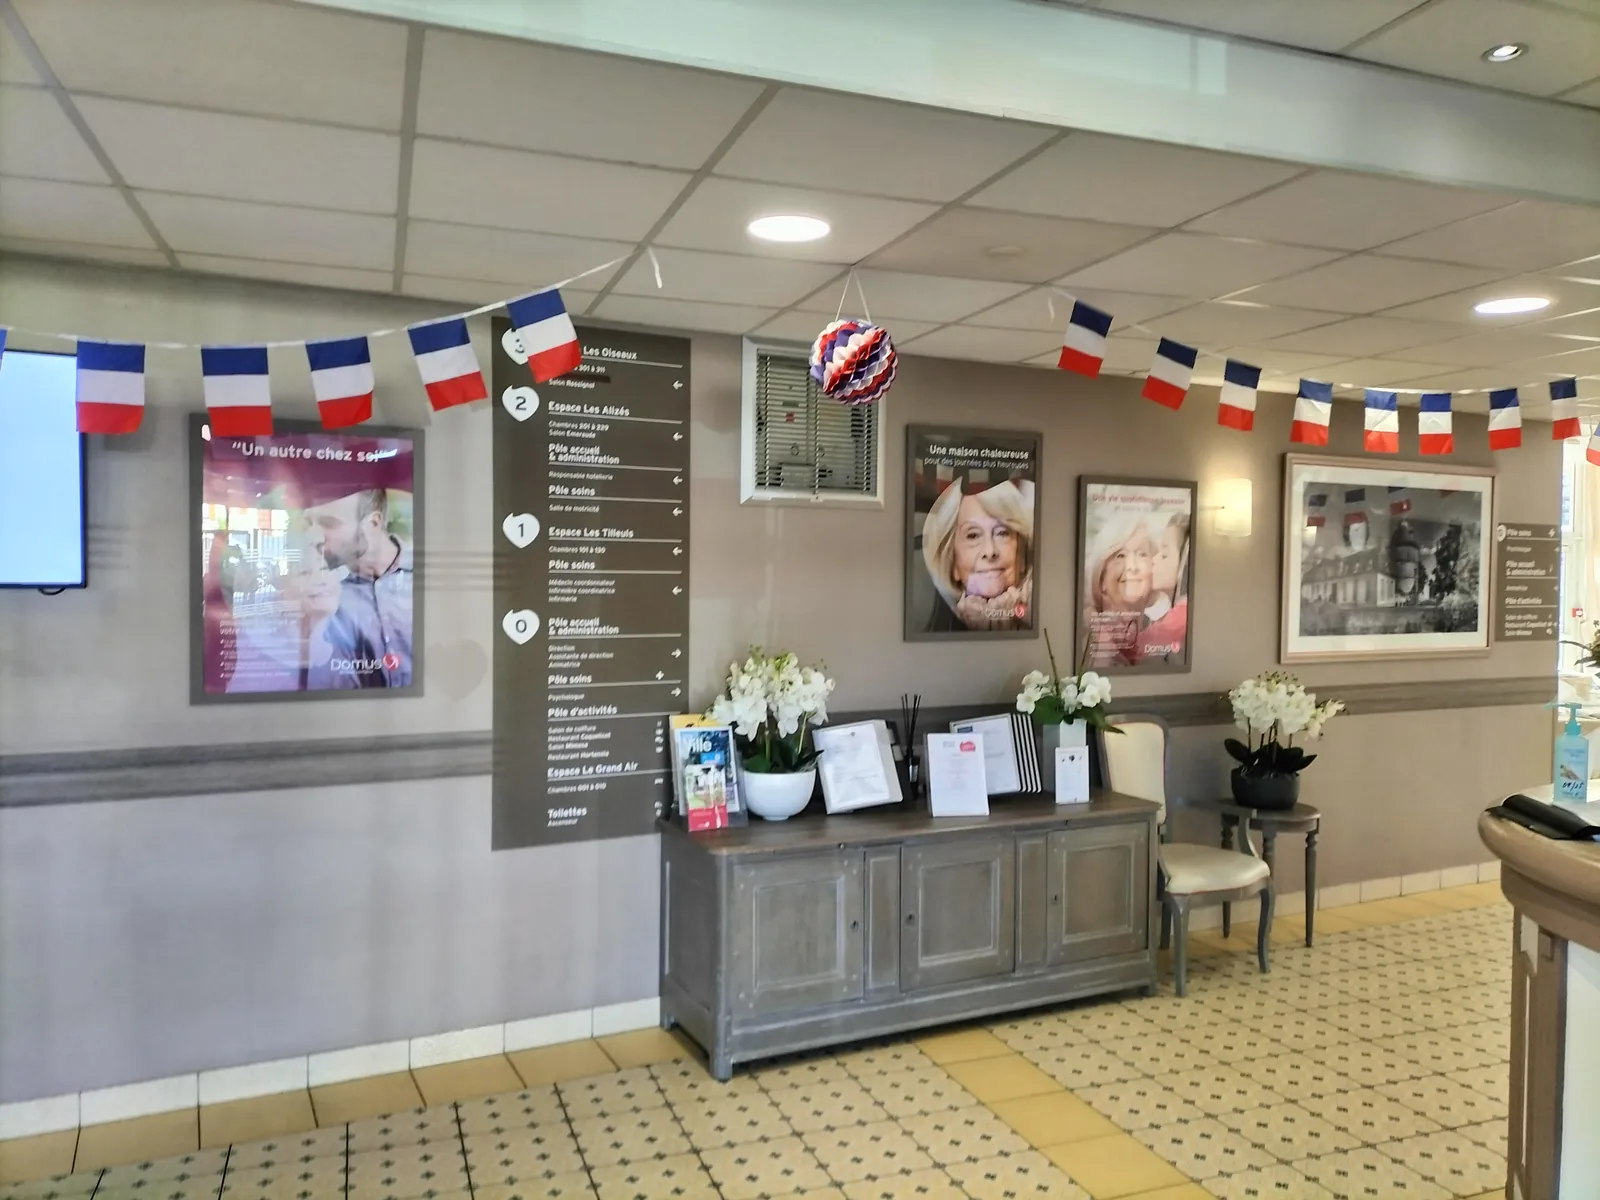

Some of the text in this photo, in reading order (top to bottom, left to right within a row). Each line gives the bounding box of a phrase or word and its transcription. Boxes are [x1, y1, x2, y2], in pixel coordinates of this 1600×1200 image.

[583, 345, 637, 360] Les Oiseaux
[548, 378, 595, 389] Salon Rossignol
[515, 396, 527, 411] 2
[548, 401, 630, 416] Espace Les Alizés
[548, 420, 578, 429] Chambres
[269, 445, 311, 459] autre
[316, 447, 353, 461] chez
[548, 443, 600, 455] Pôle accueil
[929, 444, 1029, 460] Une maison chaleureuse
[549, 452, 620, 464] & administration
[924, 457, 940, 466] pour
[548, 485, 596, 496] Pôle soins
[518, 523, 524, 537] 1
[548, 527, 634, 538] Espace Les Tilleuls
[548, 559, 596, 569] Pôle soins
[515, 619, 527, 633] 0
[548, 617, 600, 627] Pôle accueil
[549, 625, 619, 635] & administration
[548, 674, 592, 685] Pôle soins
[548, 707, 568, 717] Pôle
[547, 761, 638, 778] Espace Le Grand Air
[547, 785, 577, 794] Chambres
[547, 807, 588, 819] Toilettes
